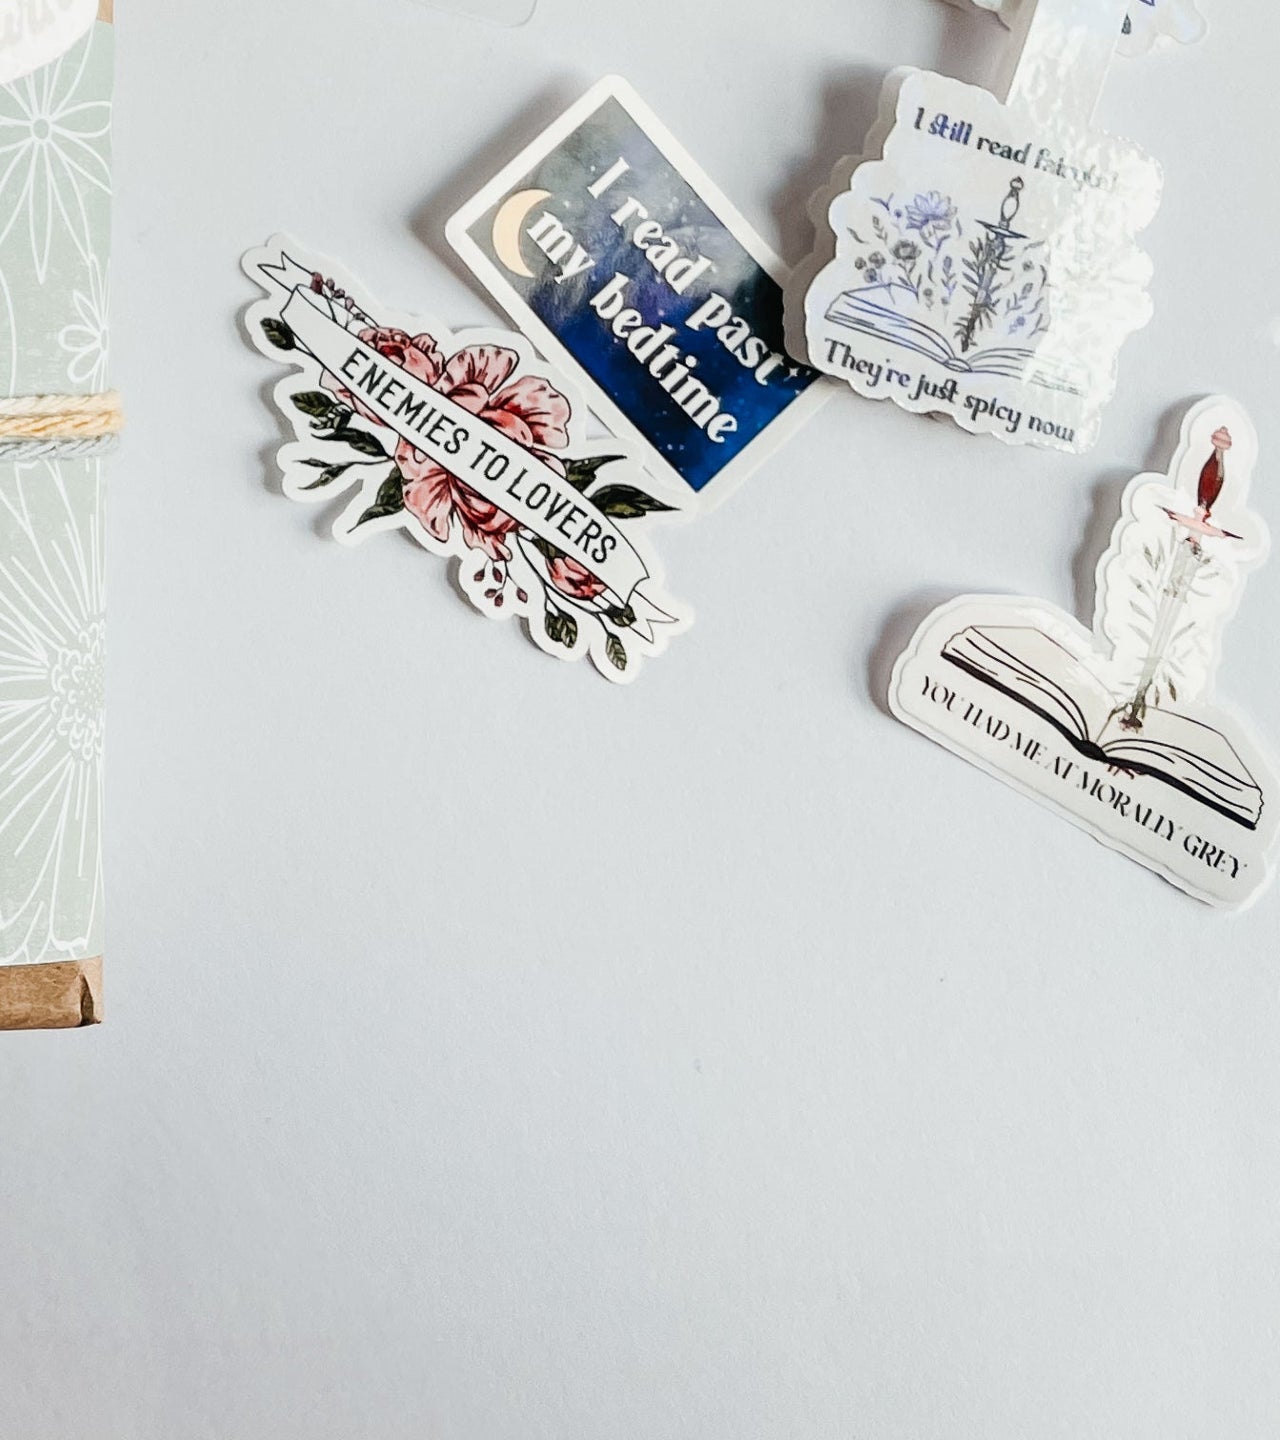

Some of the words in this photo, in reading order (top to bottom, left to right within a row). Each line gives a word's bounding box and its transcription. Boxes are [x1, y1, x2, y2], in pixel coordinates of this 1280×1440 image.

[587, 156, 632, 199] I
[913, 107, 925, 131] I
[928, 111, 973, 146] still
[976, 142, 1033, 165] read
[609, 196, 713, 295] read
[526, 211, 596, 285] my
[590, 272, 738, 443] bedtime
[685, 290, 785, 386] past
[824, 336, 911, 388] They're
[909, 373, 959, 403] just
[964, 392, 1022, 433] spicy
[1028, 413, 1076, 444] now
[340, 347, 470, 455] ENEMIES
[470, 440, 510, 481] TO
[506, 467, 617, 564] LOVERS
[921, 675, 965, 712] YOU
[964, 703, 1010, 742] HAD
[1010, 731, 1048, 761] ME
[1048, 755, 1081, 780] AT
[1076, 770, 1183, 842] MORALLY
[1183, 834, 1248, 879] GREY
